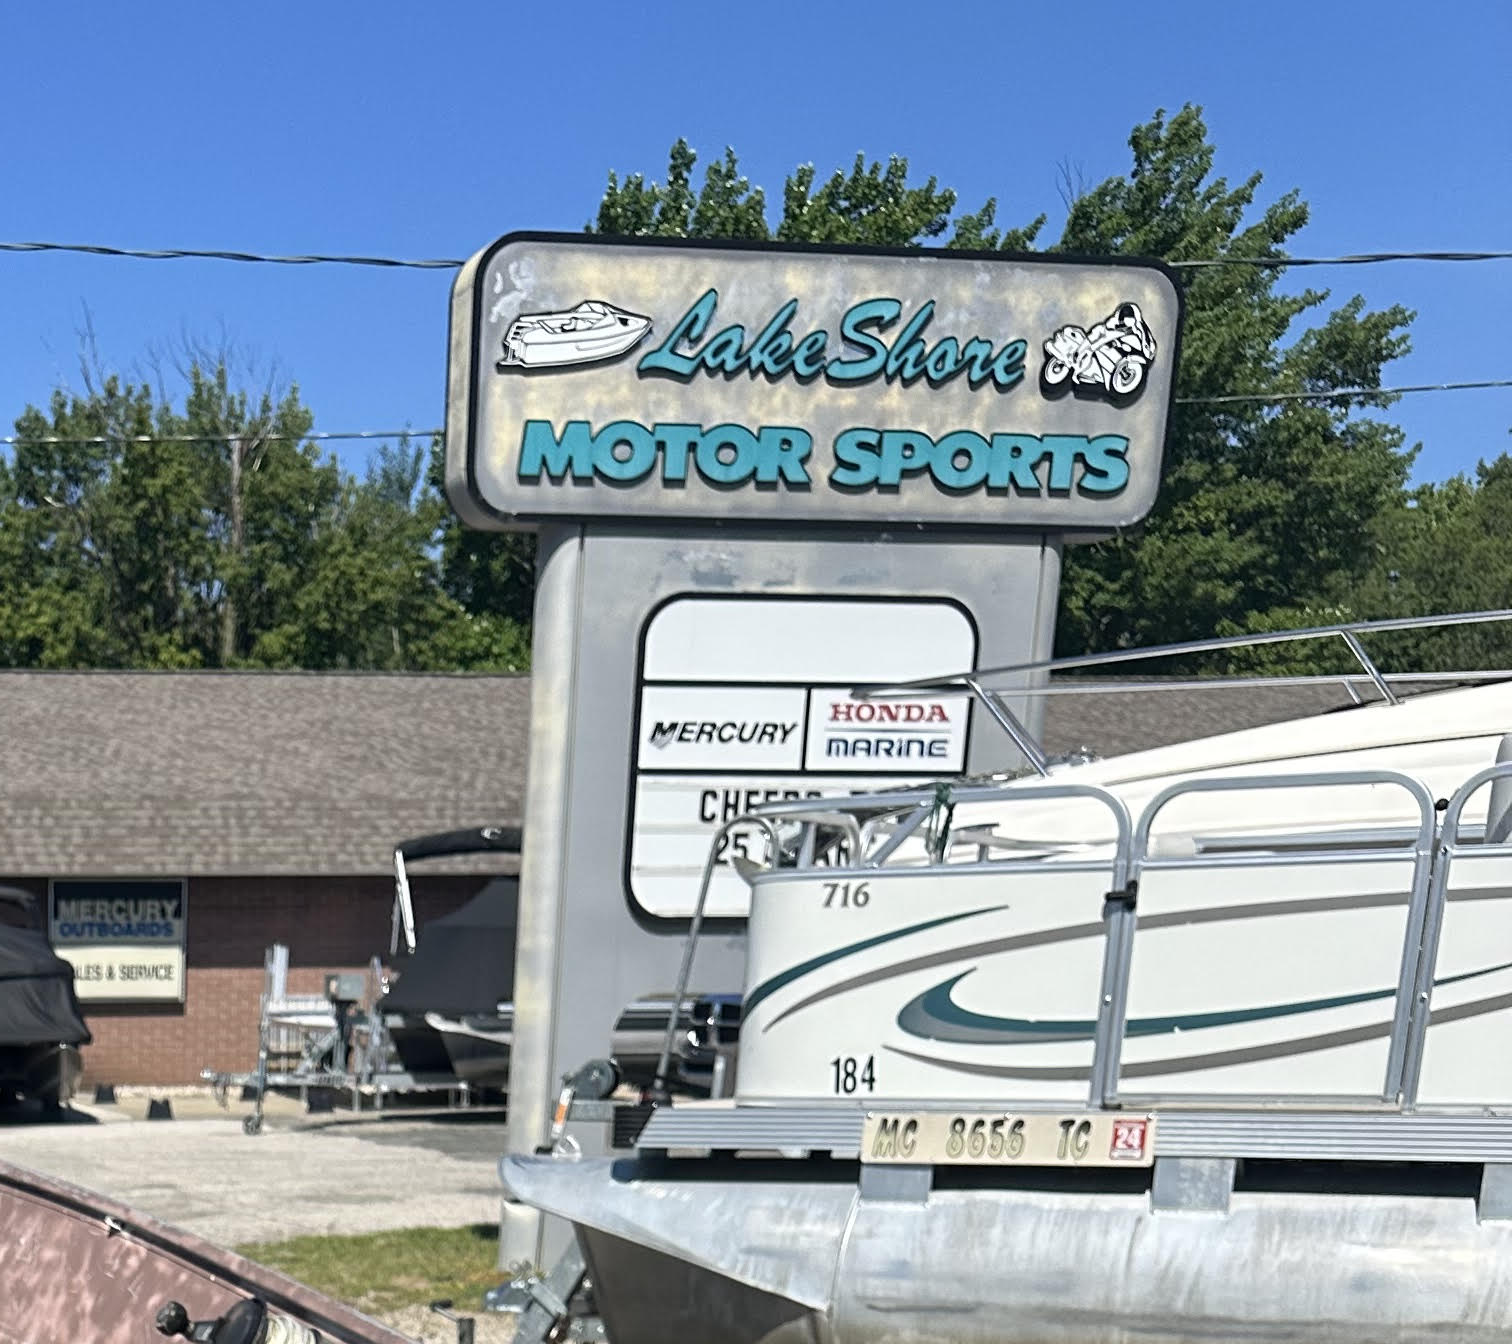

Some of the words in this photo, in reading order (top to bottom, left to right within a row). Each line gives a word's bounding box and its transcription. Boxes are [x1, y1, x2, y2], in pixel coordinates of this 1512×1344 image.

[518, 419, 812, 487] MOTOR
[829, 427, 1130, 496] SPORTS
[829, 703, 950, 723] HONDA
[649, 721, 798, 745] MERCURY
[825, 737, 949, 758] MARINE
[822, 881, 871, 909] 716
[57, 898, 178, 920] MERCURY
[60, 922, 174, 937] OUTBOARDS
[75, 964, 104, 981] ALES
[119, 964, 175, 981] SERVICE
[830, 1055, 876, 1095] 184
[871, 1117, 919, 1159] MC
[945, 1117, 1026, 1160] 8656
[1056, 1118, 1092, 1161] TC
[1115, 1126, 1142, 1149] 24
